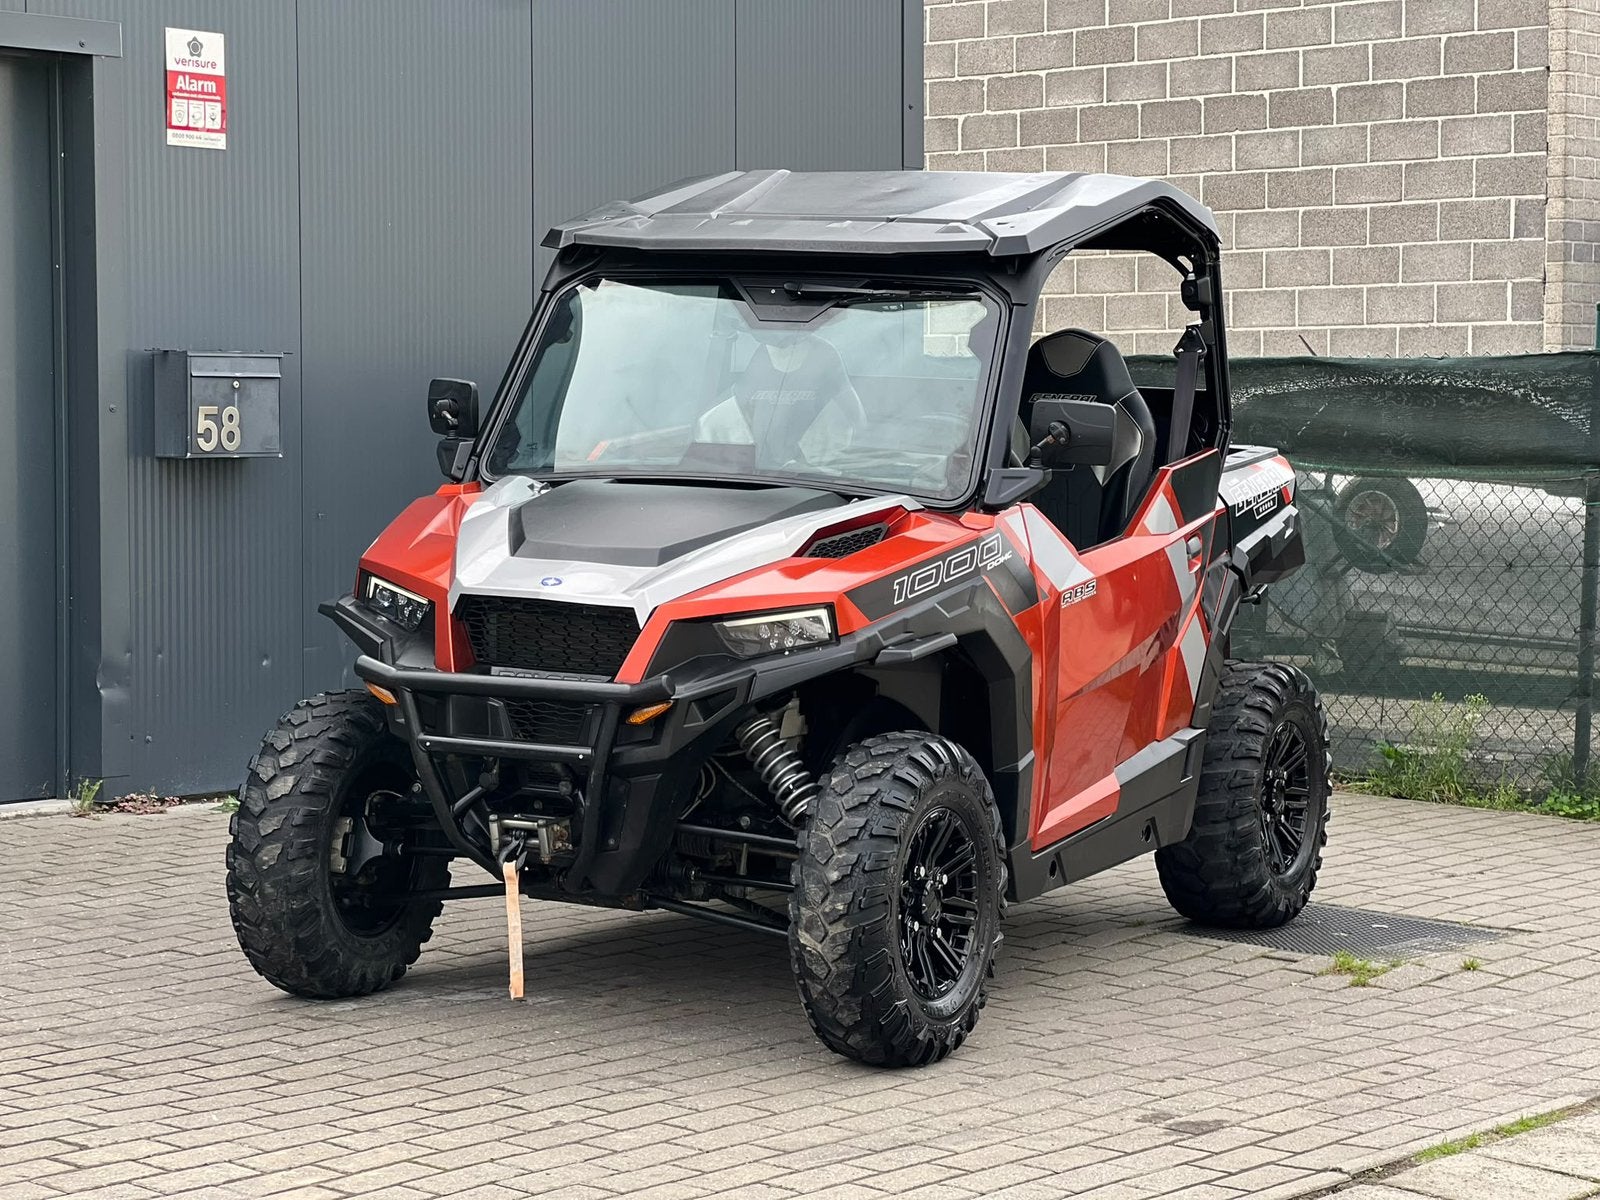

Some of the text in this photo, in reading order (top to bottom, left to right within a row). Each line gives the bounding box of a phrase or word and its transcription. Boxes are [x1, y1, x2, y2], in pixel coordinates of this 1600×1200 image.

[174, 57, 217, 69] verisure
[176, 74, 217, 93] Alarm
[197, 406, 241, 452] 58
[893, 533, 1002, 606] 1000
[986, 550, 1013, 571] DOHC
[1061, 579, 1097, 606] ABS
